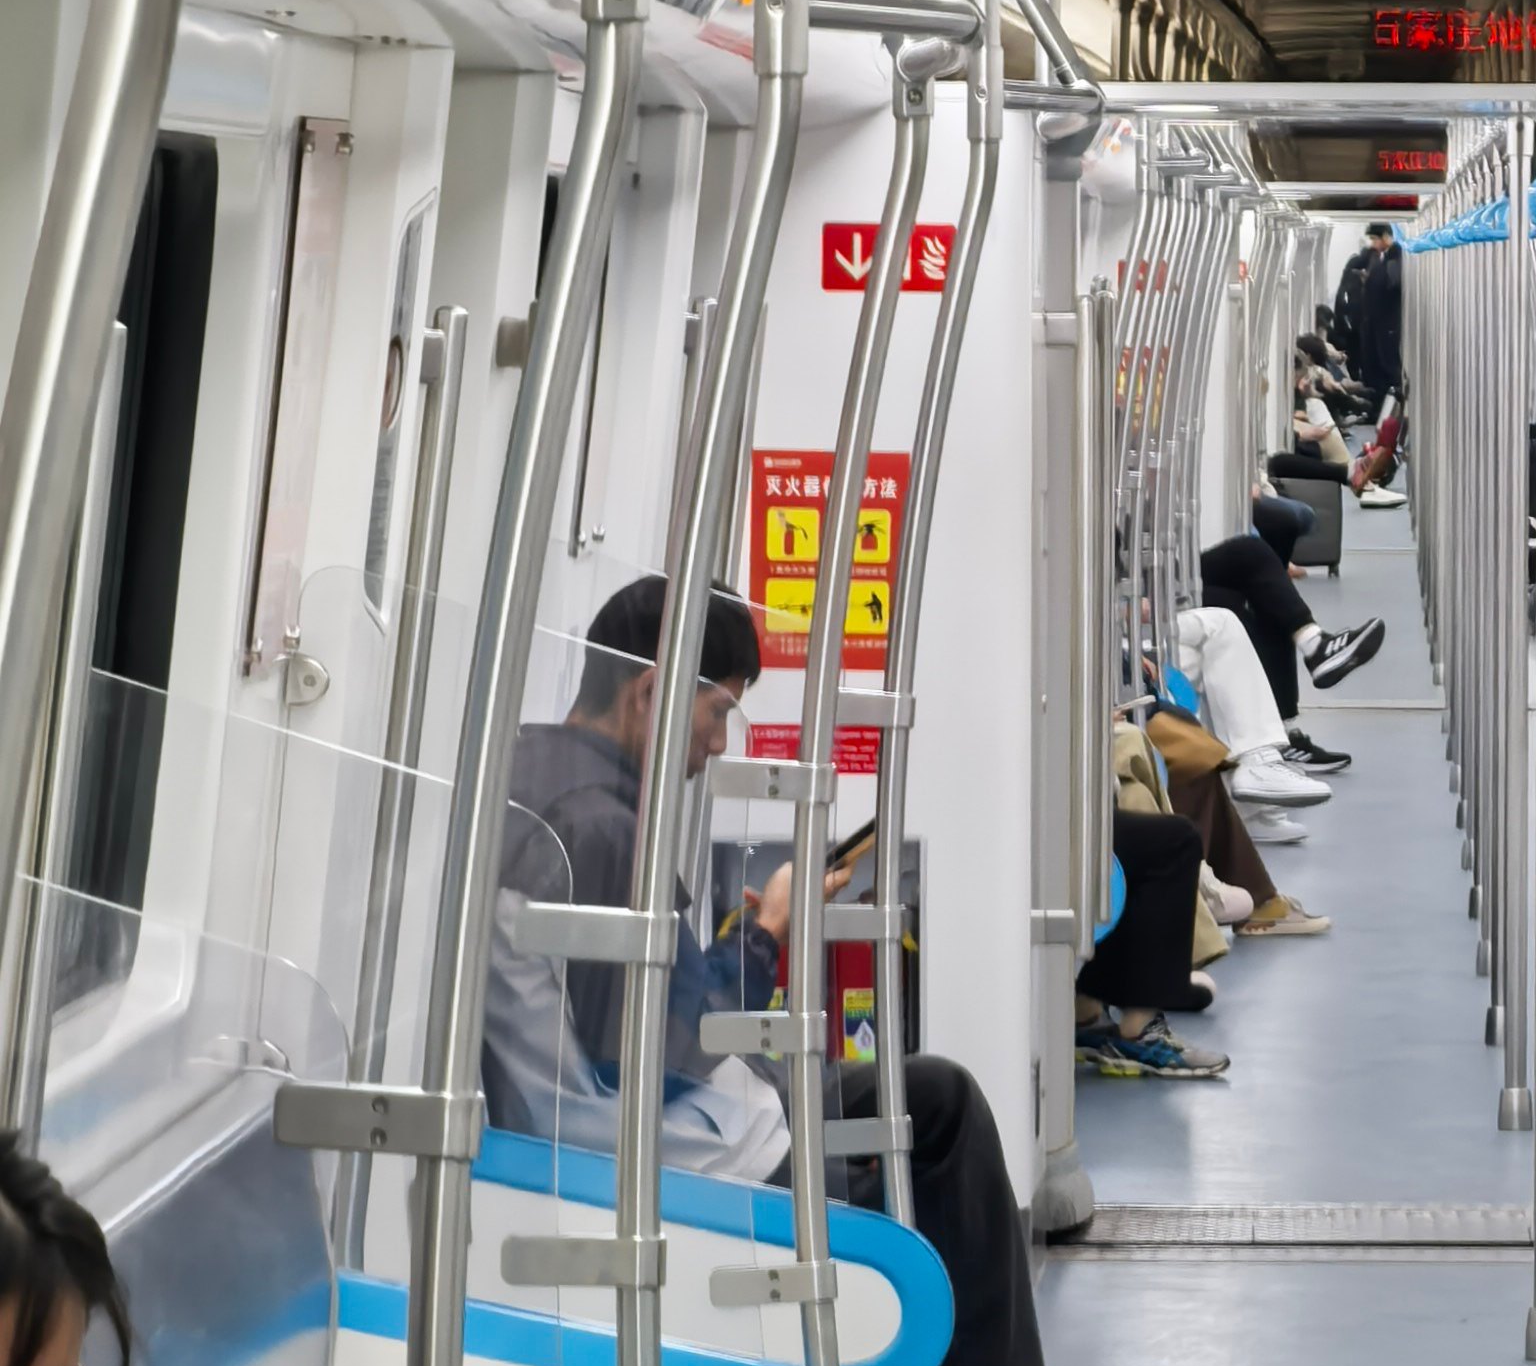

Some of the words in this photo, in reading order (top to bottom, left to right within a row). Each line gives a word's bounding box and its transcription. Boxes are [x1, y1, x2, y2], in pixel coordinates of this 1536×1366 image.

[766, 474, 898, 499] 灭火器方法
